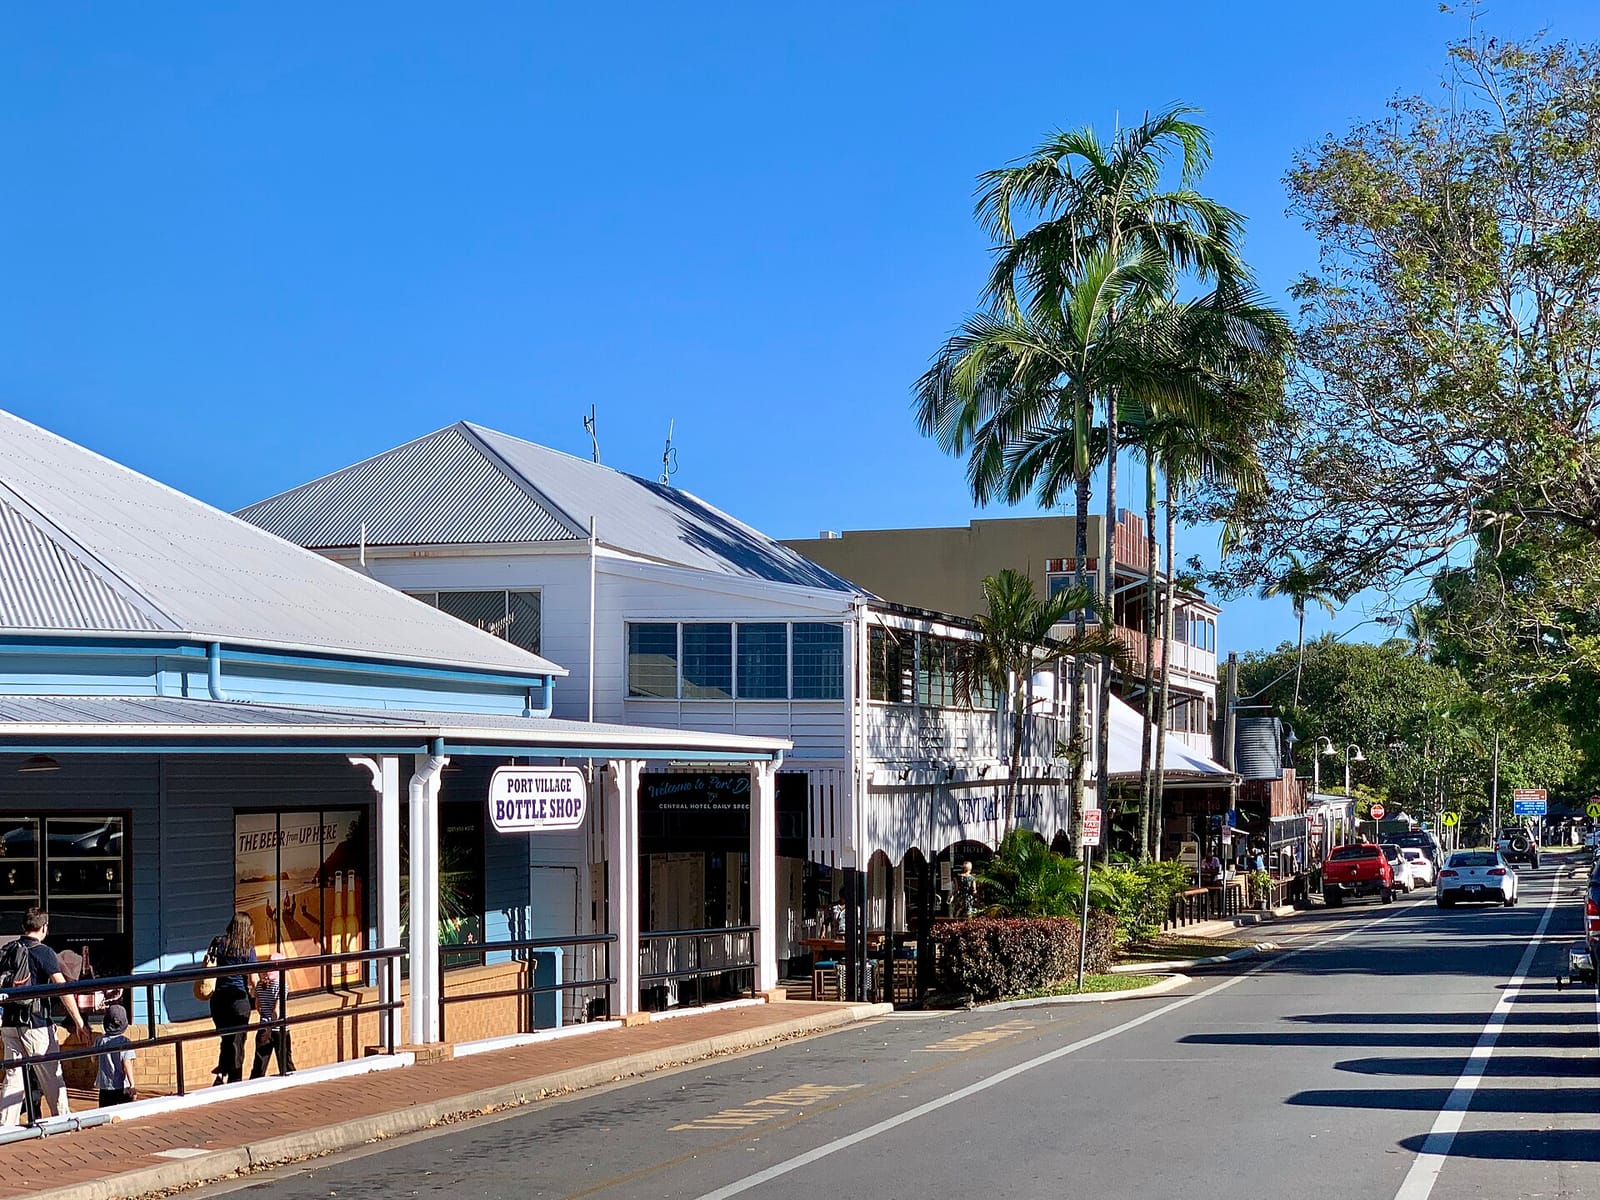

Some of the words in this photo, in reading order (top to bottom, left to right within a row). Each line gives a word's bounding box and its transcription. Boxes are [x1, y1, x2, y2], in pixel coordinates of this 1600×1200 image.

[507, 778, 533, 793] PORT
[535, 778, 572, 793] VILLAGE
[694, 778, 705, 790] to
[709, 776, 733, 789] Port
[496, 799, 547, 820] BOTTLE
[549, 798, 582, 819] SHOP
[956, 795, 999, 825] CENTRAL
[240, 834, 259, 852] THE
[260, 830, 286, 850] BEER
[285, 831, 299, 846] from
[300, 826, 313, 843] UP
[313, 823, 338, 842] HERE
